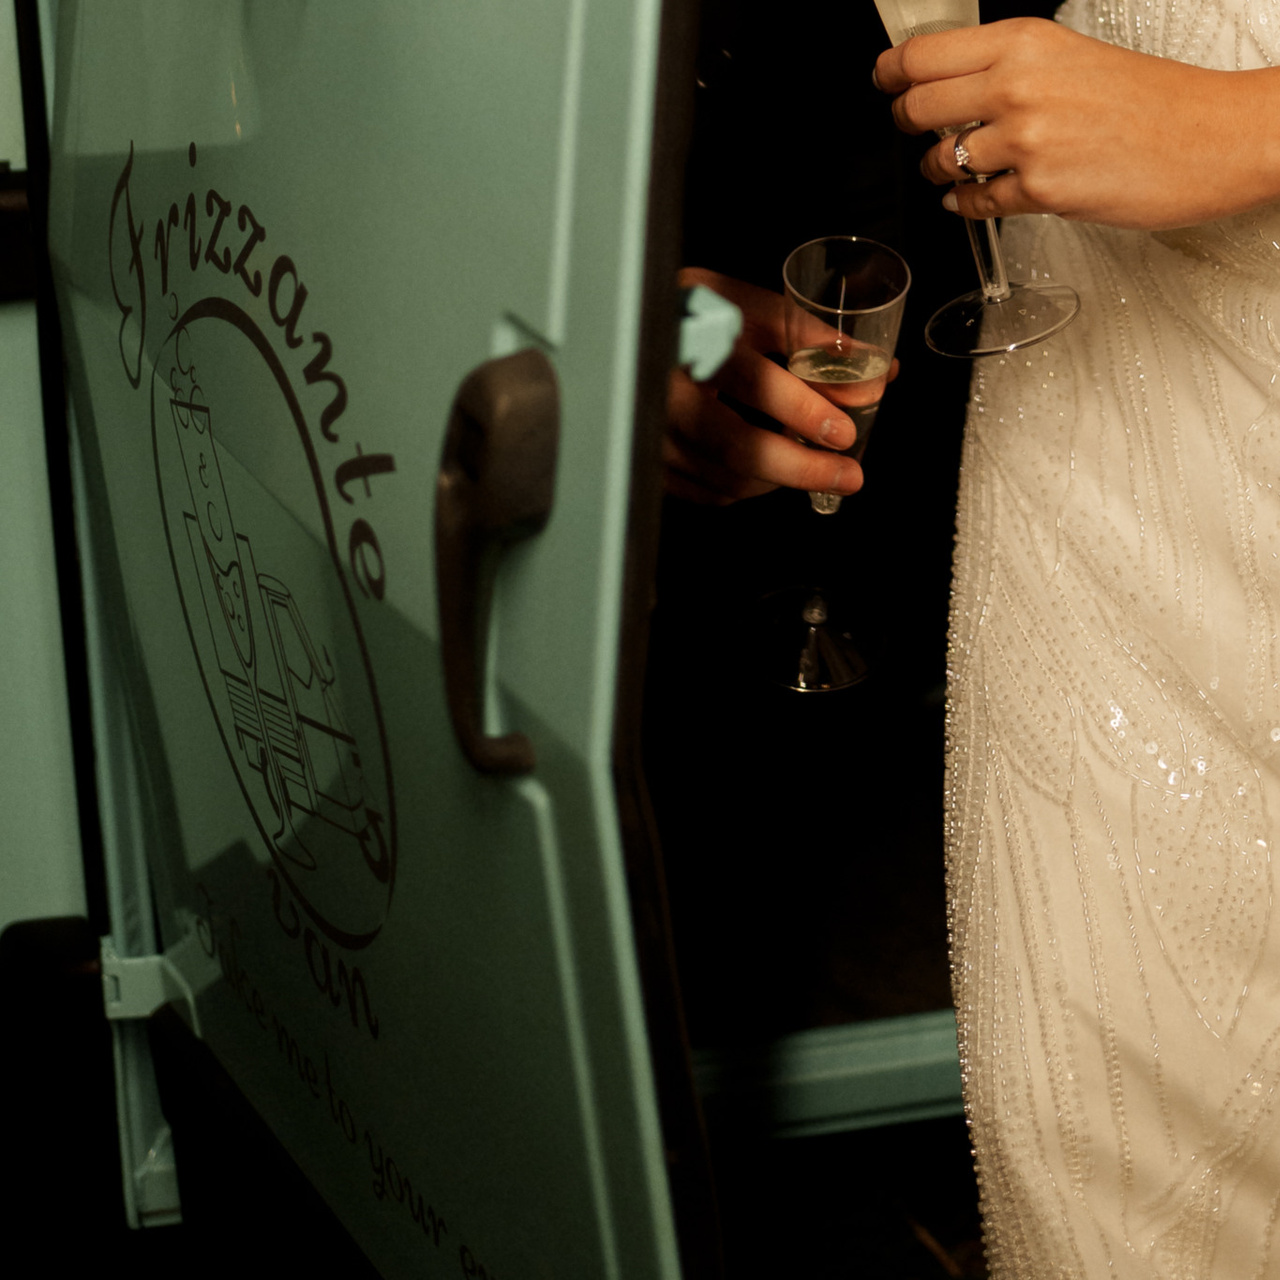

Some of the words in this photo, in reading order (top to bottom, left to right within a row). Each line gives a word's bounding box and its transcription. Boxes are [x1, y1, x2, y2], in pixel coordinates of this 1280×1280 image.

[108, 139, 397, 602] Frizzante
[266, 867, 380, 1040] van
[324, 1050, 357, 1144] to
[364, 1130, 448, 1247] your
